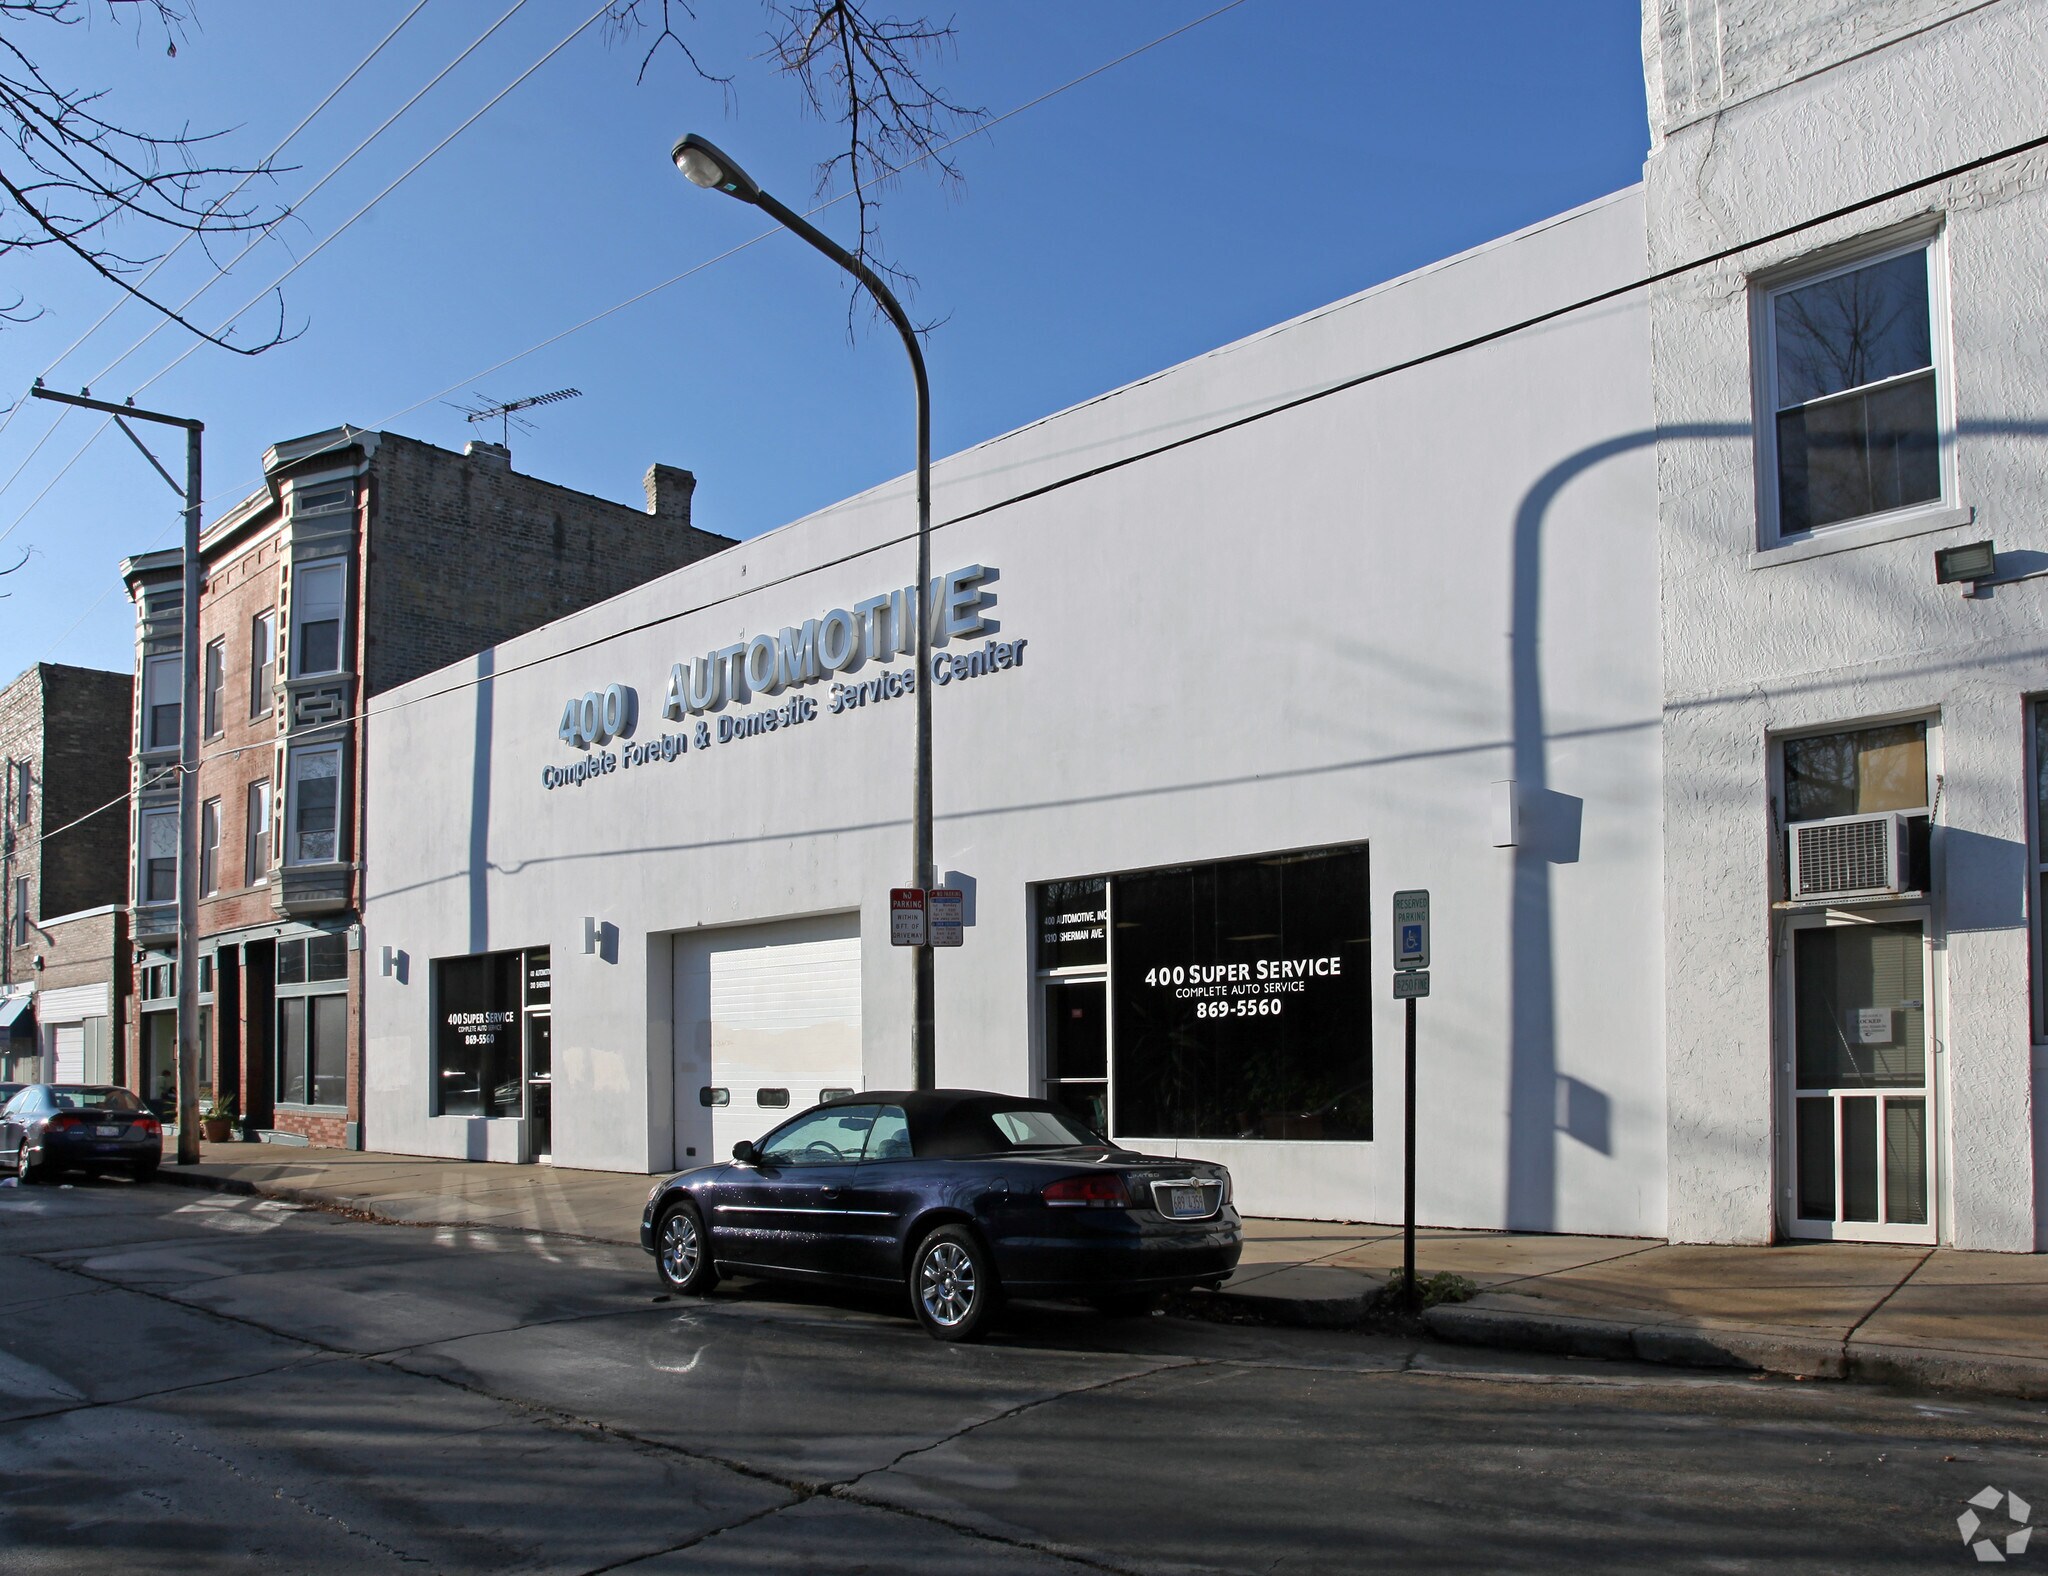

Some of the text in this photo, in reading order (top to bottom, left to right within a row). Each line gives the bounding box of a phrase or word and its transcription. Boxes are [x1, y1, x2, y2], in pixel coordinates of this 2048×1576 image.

[558, 564, 986, 749] 400 AUTOMOTIVE
[542, 638, 1028, 790] Complete Foreign & Domestic Service Center
[893, 900, 922, 908] PARKING
[1396, 898, 1428, 909] RESERVED
[1045, 916, 1055, 925] 400
[1398, 911, 1426, 922] PARKING
[1059, 930, 1089, 942] SHERMAN
[1090, 928, 1104, 939] AVE.
[1145, 956, 1342, 987] 400 SUPER SERVICE
[1175, 980, 1305, 998] COMPLETE AUTO SERVICE
[1414, 978, 1428, 990] FINE
[1196, 998, 1282, 1018] 869-5560
[448, 1011, 514, 1025] 400 SUPER SERVICE
[458, 1025, 476, 1033] COMPLETE
[477, 1024, 487, 1032] AUTO
[465, 1033, 495, 1045] 869-5560
